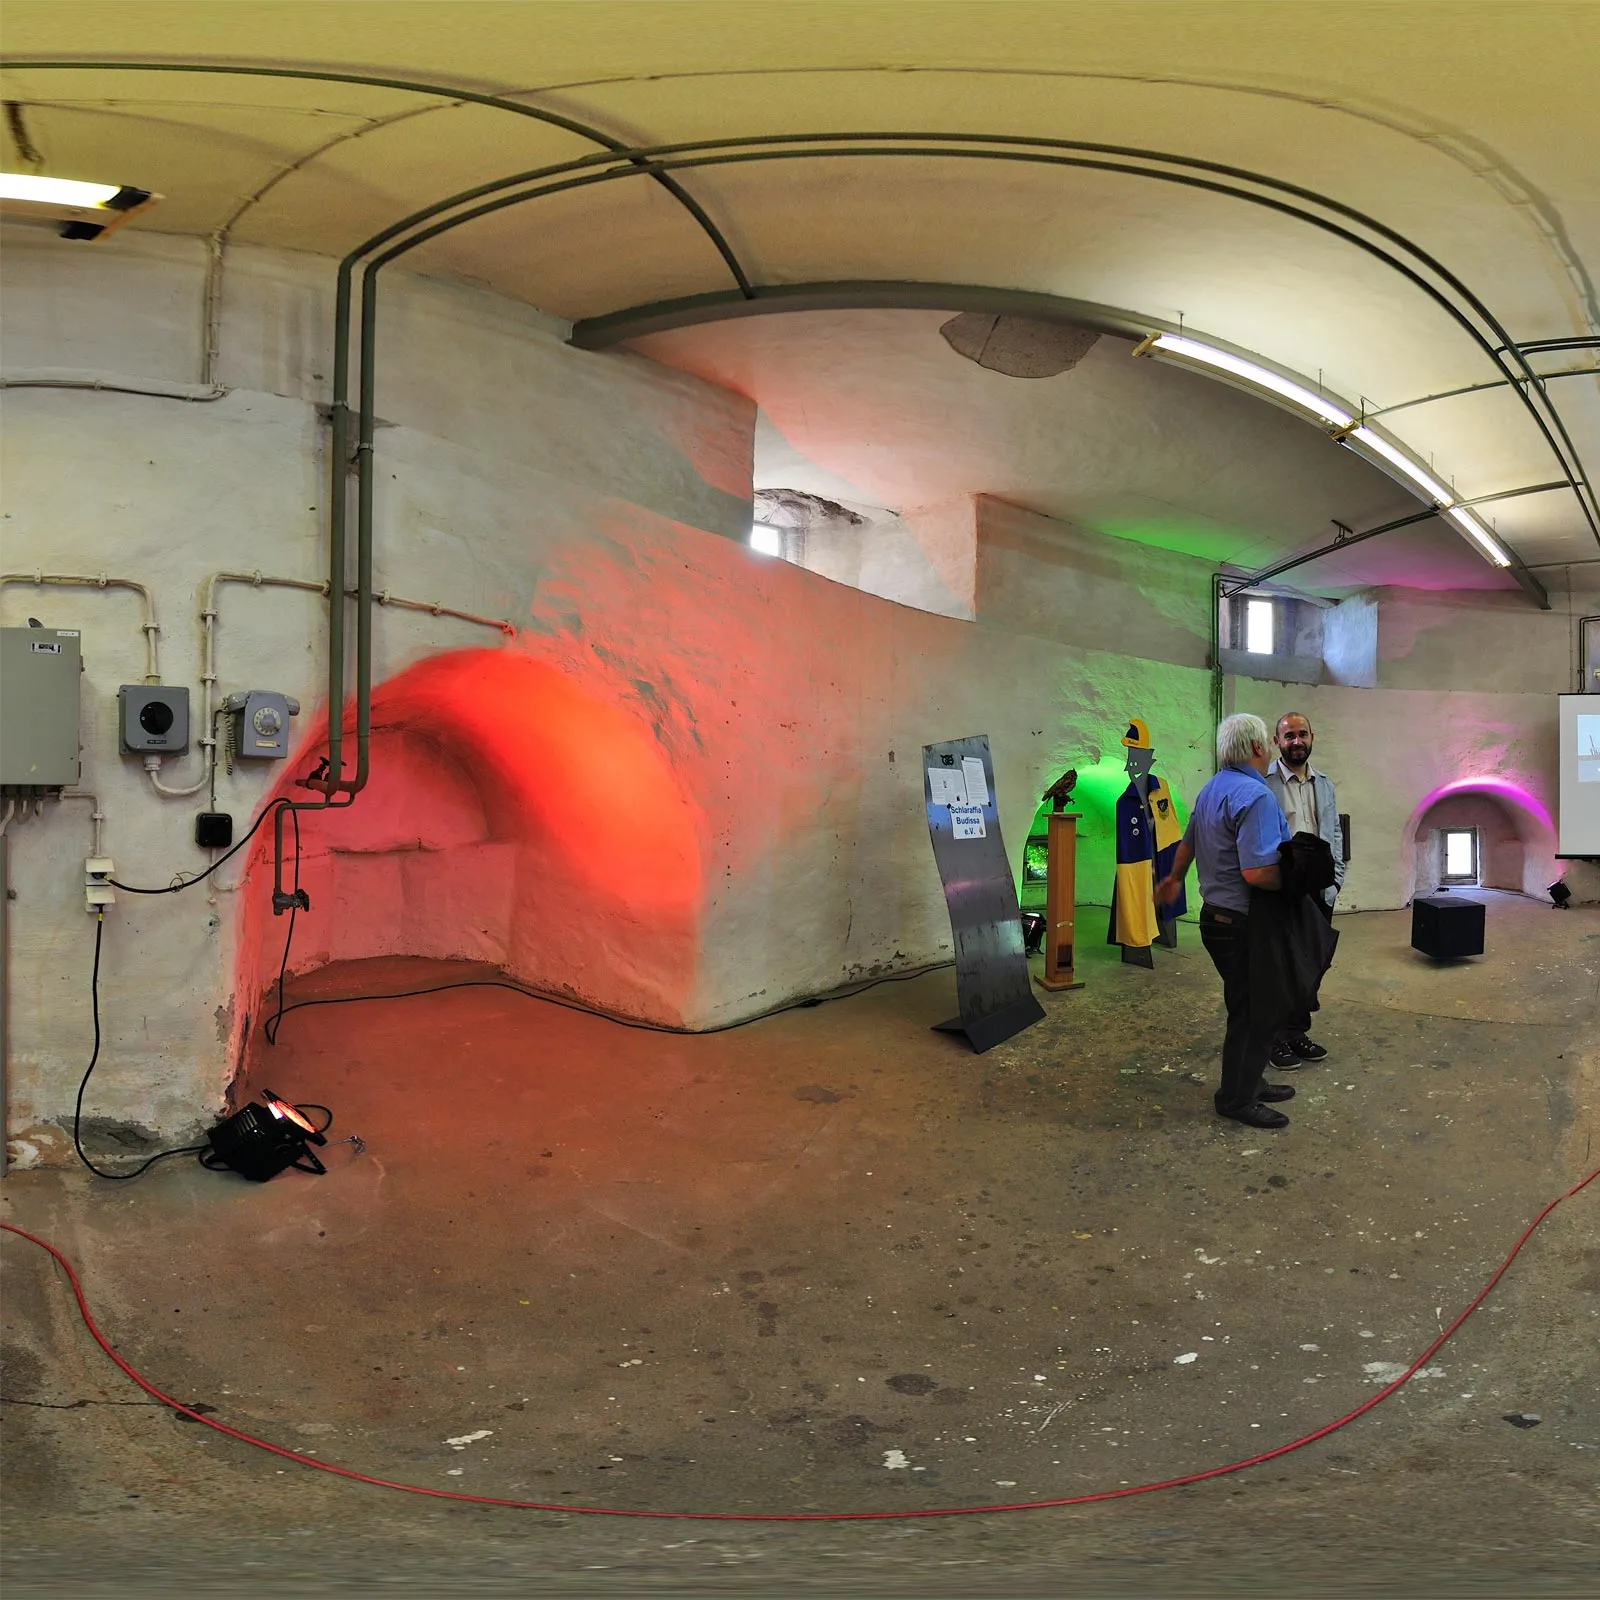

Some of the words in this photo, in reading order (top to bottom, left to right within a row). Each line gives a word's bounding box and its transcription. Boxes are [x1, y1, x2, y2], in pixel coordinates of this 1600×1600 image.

[950, 806, 982, 814] Schlaraffia
[956, 816, 980, 825] Budissa
[964, 827, 976, 836] e.V.
